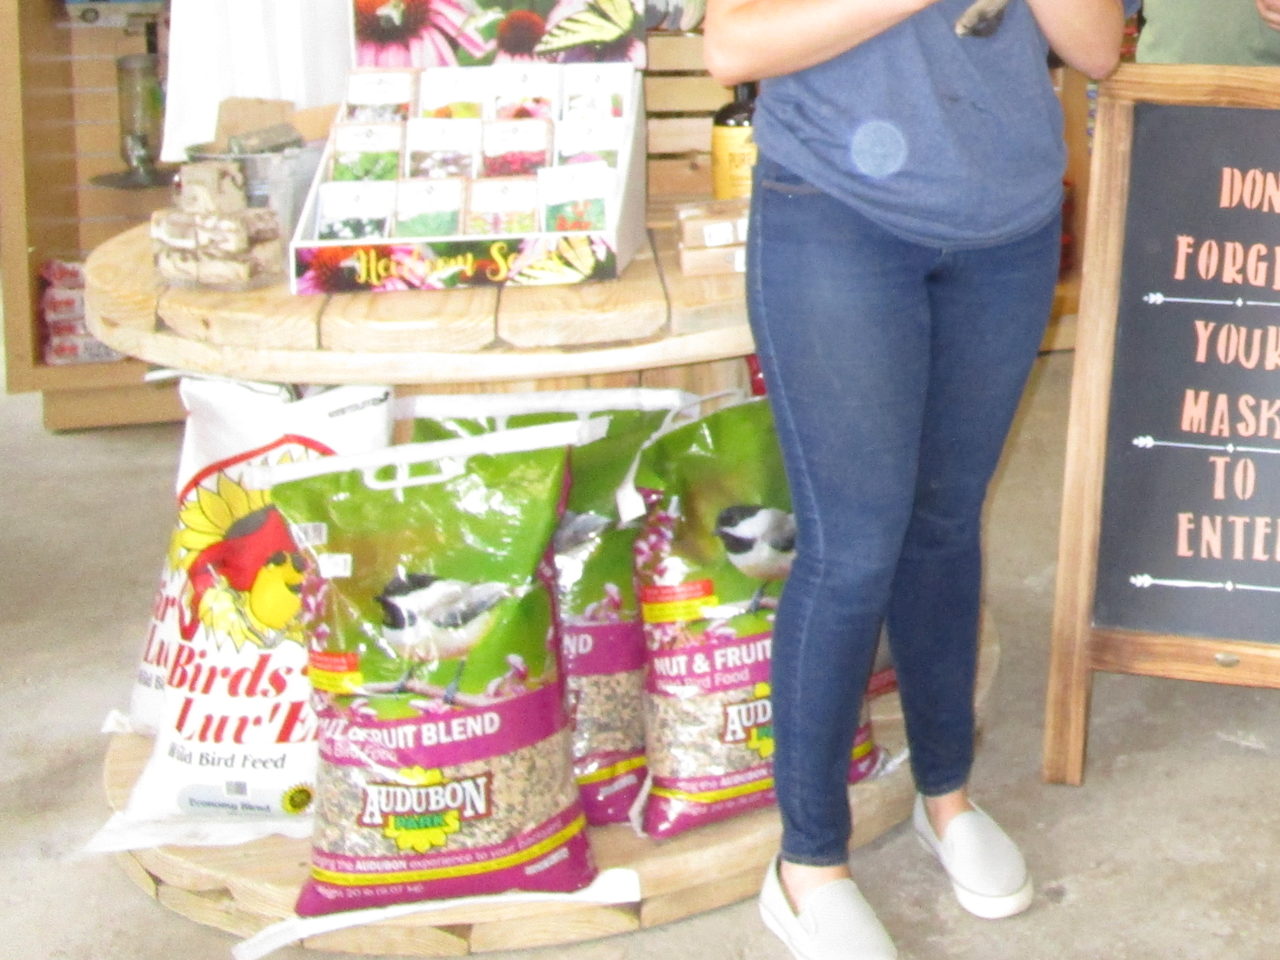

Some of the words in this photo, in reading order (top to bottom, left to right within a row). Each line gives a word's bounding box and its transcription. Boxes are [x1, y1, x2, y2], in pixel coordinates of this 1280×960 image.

[1208, 455, 1257, 501] TO
[167, 642, 294, 699] Birds
[653, 654, 689, 677] NUT
[692, 652, 711, 674] &
[713, 639, 773, 671] FRUIT
[714, 667, 751, 687] Food
[421, 711, 502, 748] BLEND
[198, 751, 236, 770] Bird
[241, 752, 287, 770] Feed
[361, 776, 489, 825] AUDUBON
[355, 860, 408, 872] AUDUBON
